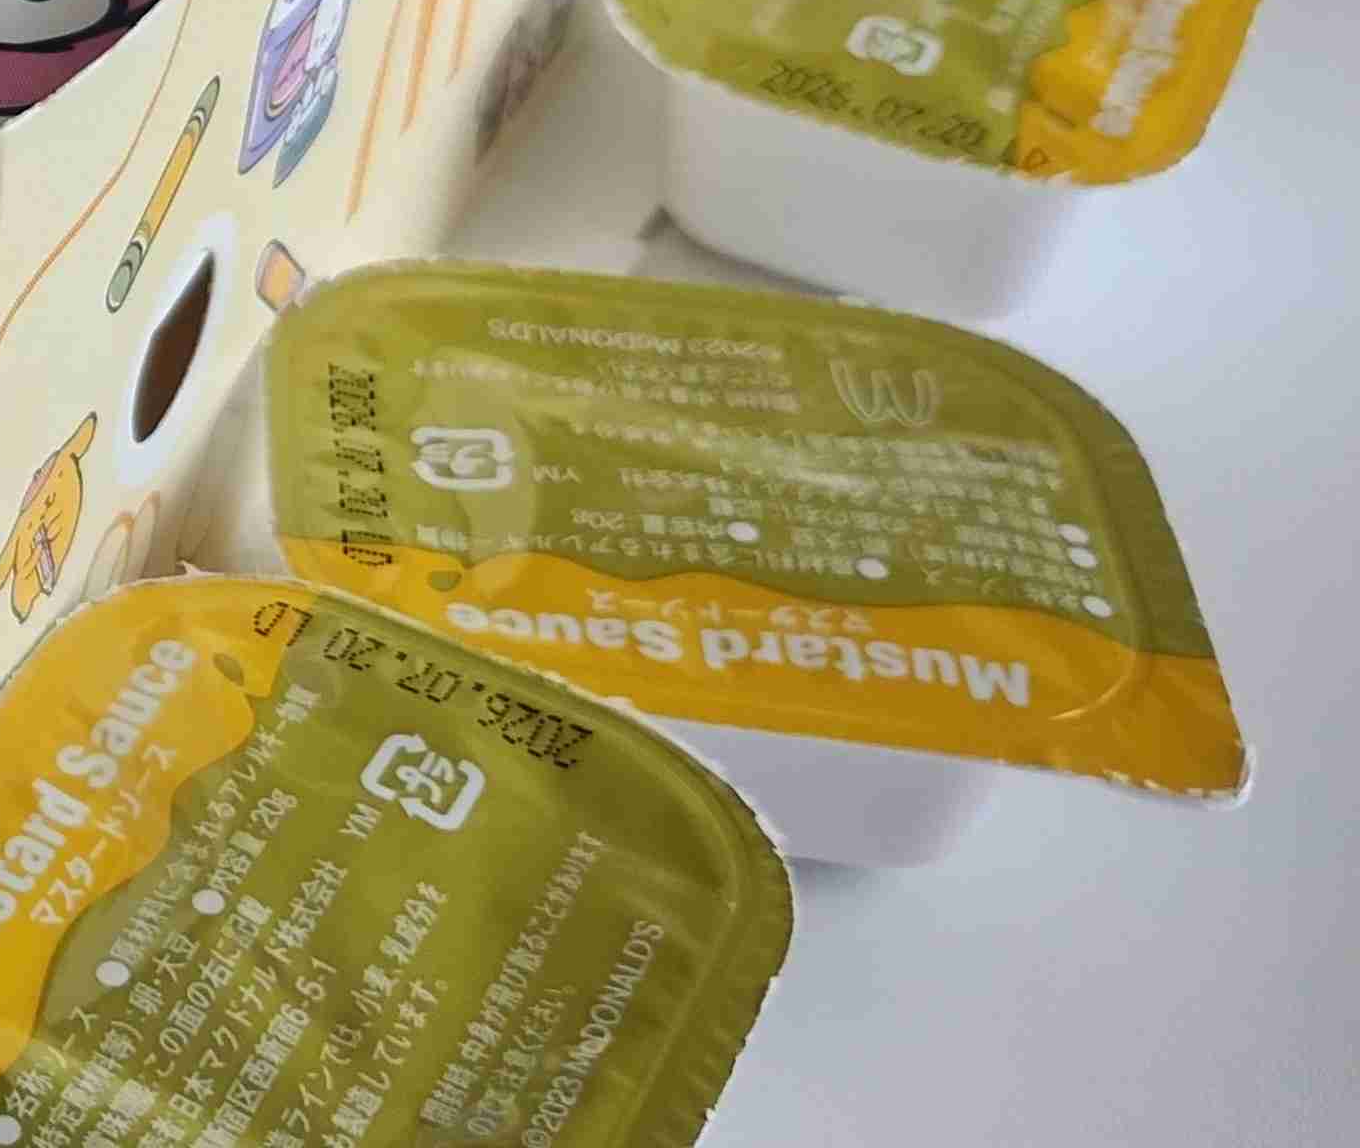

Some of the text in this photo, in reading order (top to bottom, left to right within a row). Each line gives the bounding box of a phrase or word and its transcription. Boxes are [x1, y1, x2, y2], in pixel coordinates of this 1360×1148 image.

[530, 464, 582, 484] YM
[55, 638, 198, 789] Sauce
[253, 600, 594, 770] 2026.07.20 LD
[445, 602, 1030, 709] Mustard Sauce
[29, 742, 177, 926] マスタードソース
[340, 802, 383, 841] YM
[559, 919, 665, 1077] McDONALD'S
